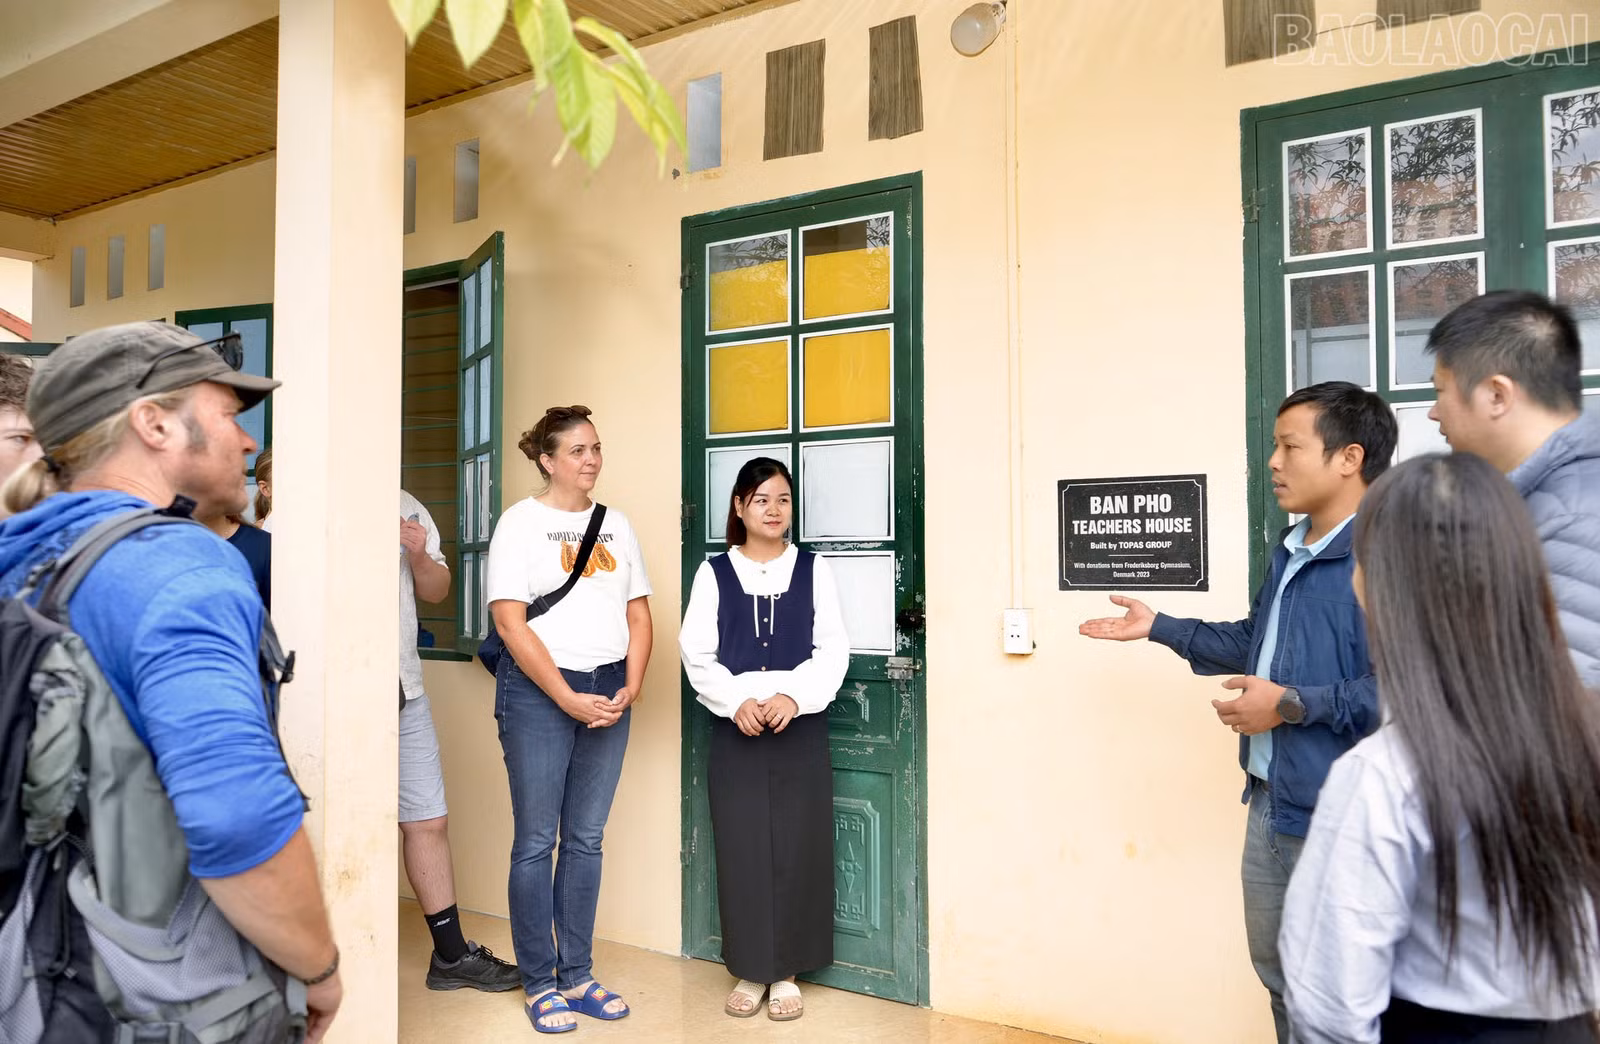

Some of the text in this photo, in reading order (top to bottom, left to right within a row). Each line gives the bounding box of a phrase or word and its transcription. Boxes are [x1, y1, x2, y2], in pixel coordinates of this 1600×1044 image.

[1090, 494, 1171, 514] BAN PHO
[1072, 518, 1192, 534] TEACHERS HOUSE
